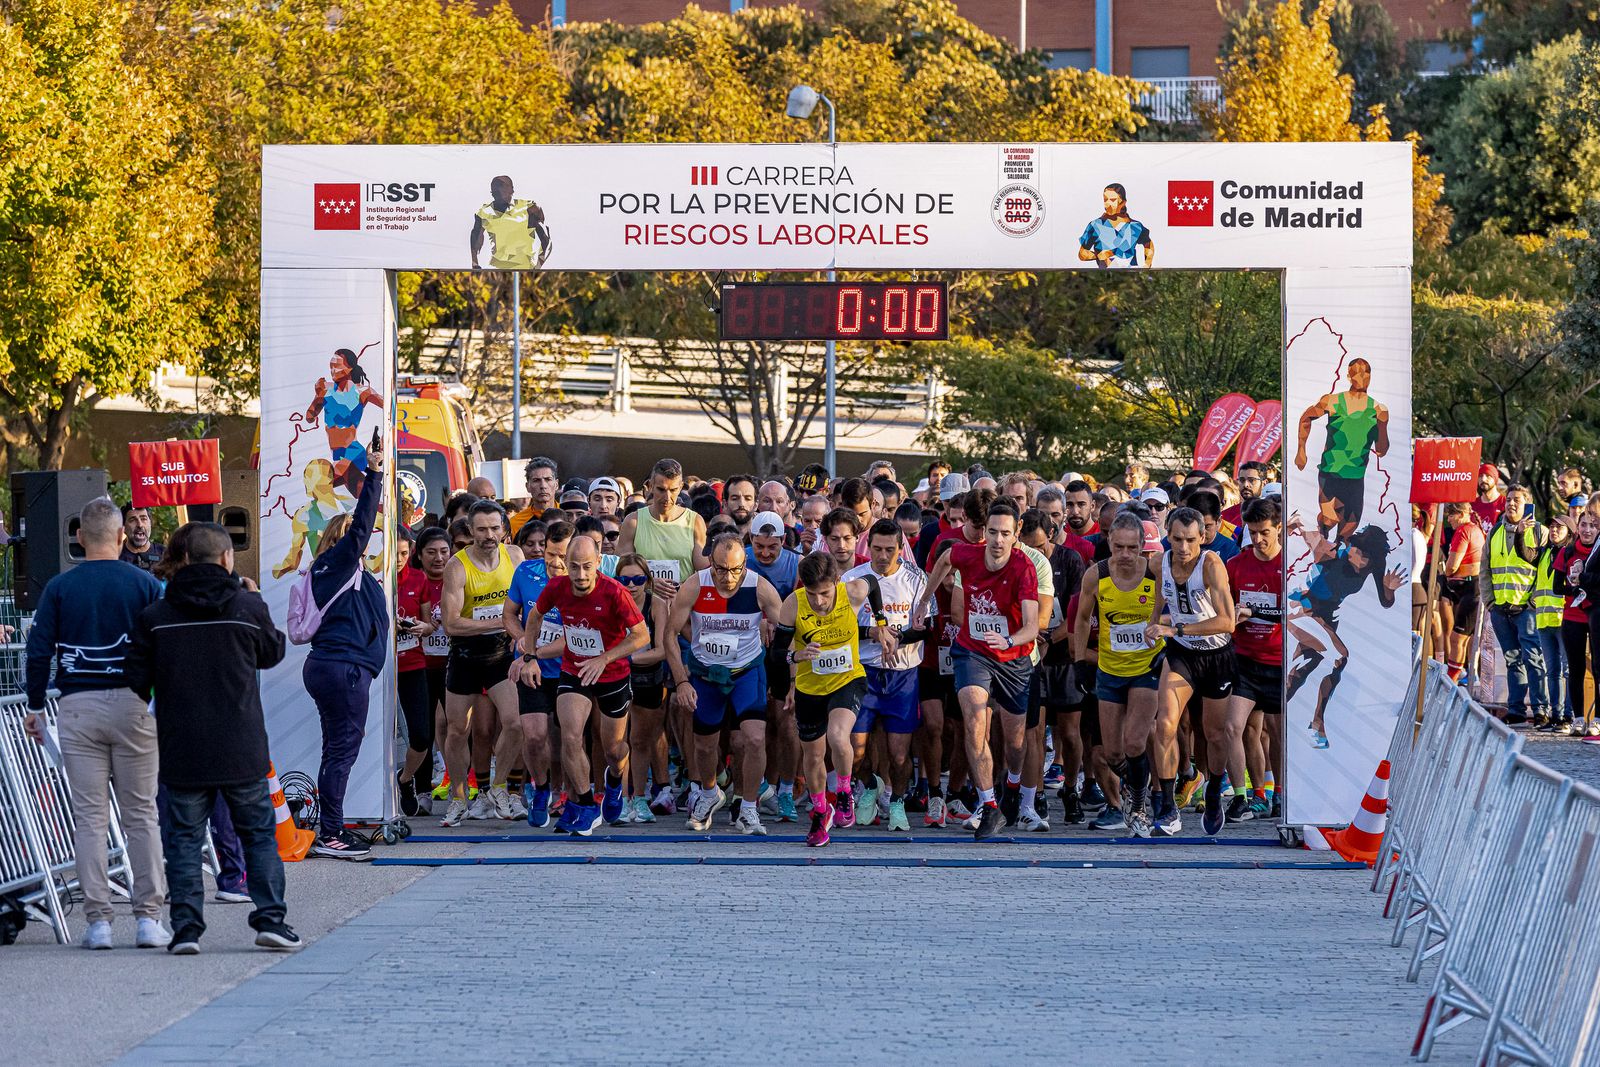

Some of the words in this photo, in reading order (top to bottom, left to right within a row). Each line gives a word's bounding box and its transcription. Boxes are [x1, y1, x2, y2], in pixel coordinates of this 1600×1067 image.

[691, 166, 718, 186] III
[726, 166, 854, 186] CARRERA
[366, 182, 436, 203] IRSST
[1023, 186, 1039, 202] CONTRA
[1220, 179, 1364, 200] Comunidad
[599, 193, 660, 215] POR
[670, 193, 706, 215] LA
[714, 187, 904, 215] PREVENCIÓN
[915, 193, 954, 215] DE
[1005, 198, 1032, 210] DRO
[395, 206, 426, 214] Regional
[376, 214, 411, 223] Seguridad
[417, 214, 437, 222] Salud
[1005, 211, 1032, 223] GAS
[1220, 206, 1255, 228] de
[1264, 206, 1362, 229] Madrid
[376, 223, 383, 231] el
[384, 223, 410, 232] Trabajo
[624, 224, 748, 246] RIESGOS
[758, 224, 929, 246] LABORALES
[837, 288, 940, 333] 0:00
[161, 461, 185, 472] SUB
[1438, 459, 1456, 469] SUB
[141, 476, 155, 486] 35
[157, 473, 209, 485] MINUTOS
[1421, 472, 1432, 482] 35
[1433, 471, 1472, 482] MINUTOS
[975, 621, 1002, 634] 0016
[570, 635, 597, 649] 0012
[1116, 632, 1143, 644] 0018
[705, 641, 731, 656] 0017
[818, 654, 846, 668] 0019
